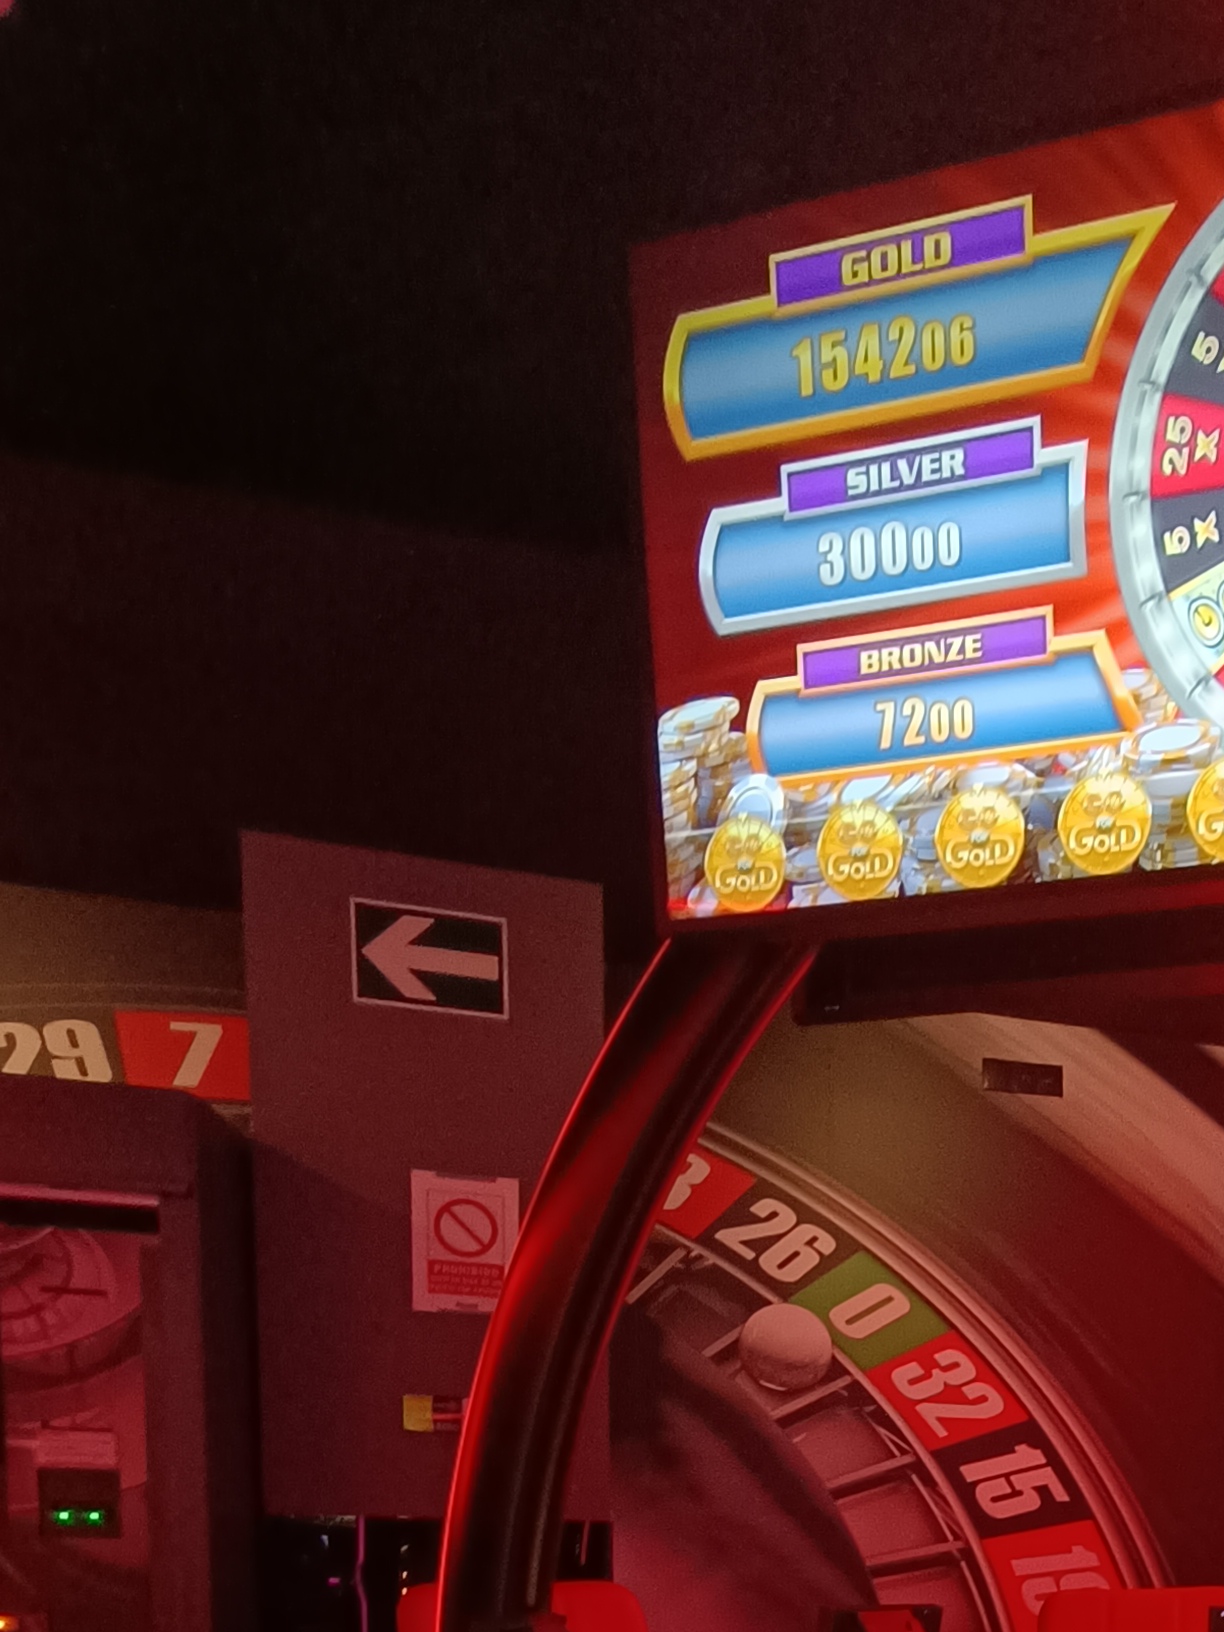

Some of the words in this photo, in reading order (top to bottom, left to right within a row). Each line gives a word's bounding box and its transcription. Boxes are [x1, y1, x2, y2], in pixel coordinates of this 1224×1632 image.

[840, 231, 952, 287] GOLD
[791, 314, 976, 396] 154206
[1192, 331, 1219, 365] 5
[846, 448, 965, 496] SILVER
[1161, 415, 1193, 476] 25
[817, 521, 961, 587] 30000
[1163, 525, 1190, 556] 5
[859, 634, 983, 676] BRONZE
[875, 698, 974, 749] 7200
[945, 836, 1014, 868] GOLD
[1070, 822, 1142, 855] GOLD
[715, 864, 777, 893] GOLD
[828, 850, 893, 881] GOLD
[0, 1019, 113, 1083] 29
[169, 1021, 224, 1089] 7
[715, 1197, 837, 1283] 26
[829, 1283, 910, 1339] 0
[891, 1348, 1004, 1438] 32
[960, 1443, 1070, 1519] 15
